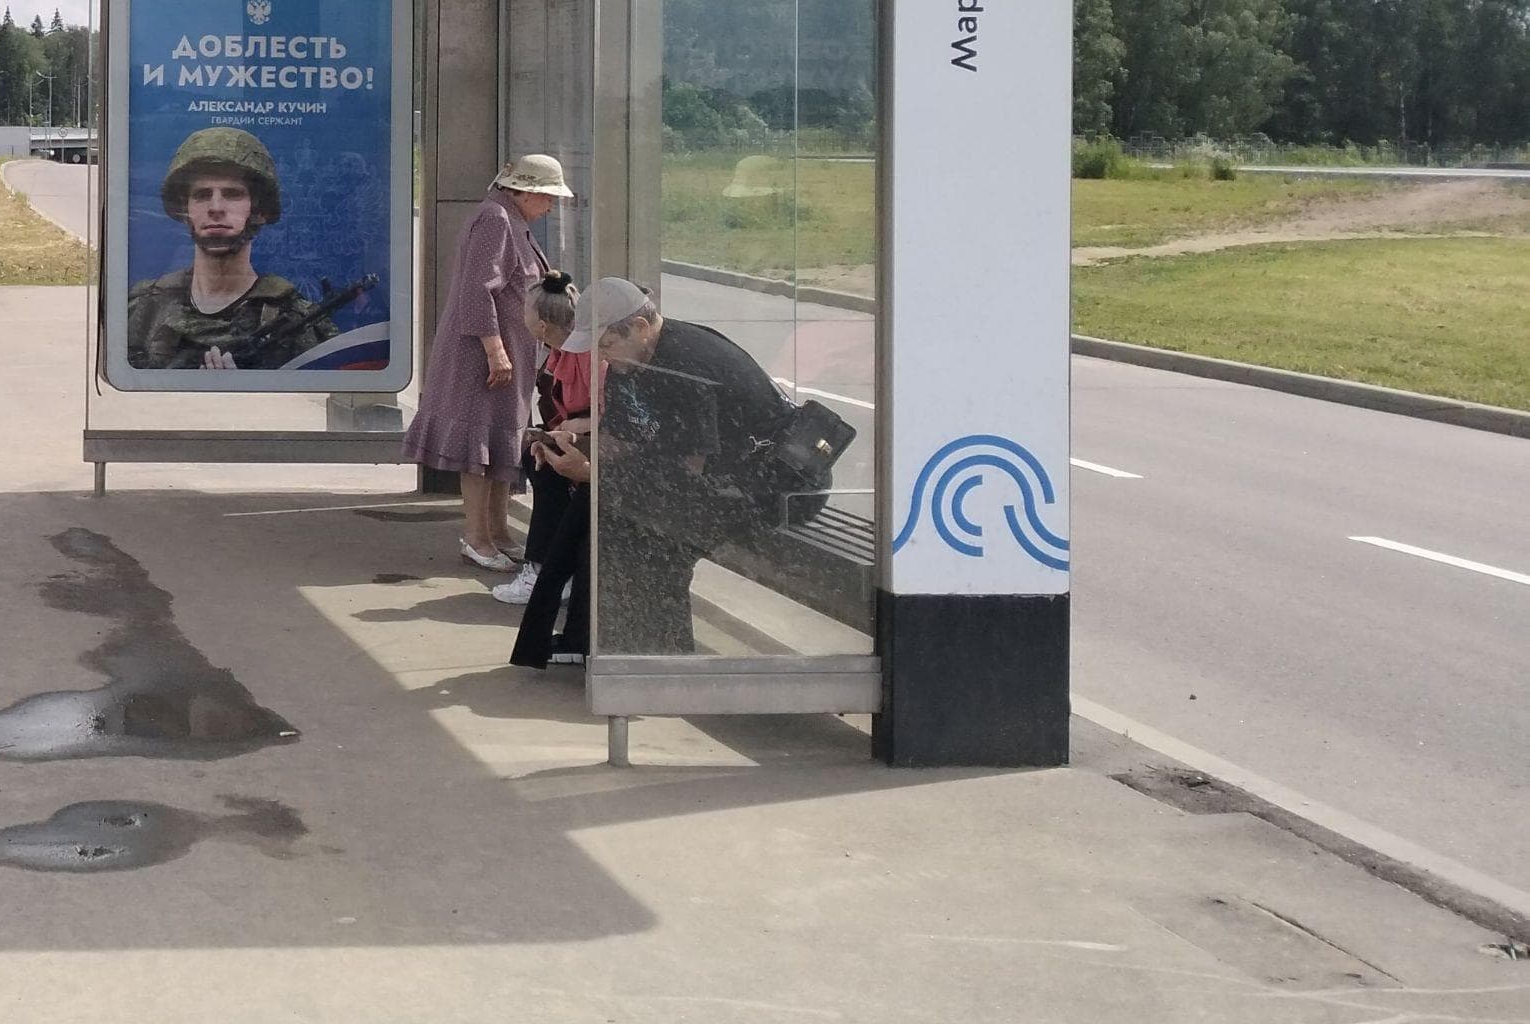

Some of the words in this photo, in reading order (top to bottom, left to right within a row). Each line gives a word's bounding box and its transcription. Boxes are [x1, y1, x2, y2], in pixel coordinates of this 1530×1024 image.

[172, 34, 347, 60] ДОБЛЕСТЬ
[143, 63, 164, 87] И
[177, 64, 374, 90] МУЖЕСТВО!
[188, 100, 274, 114] АЛЕКСАНДР
[277, 102, 327, 114] КУЧИН
[210, 116, 255, 126] ГВАРДИИ
[257, 117, 303, 127] СЕРЖАНТ
